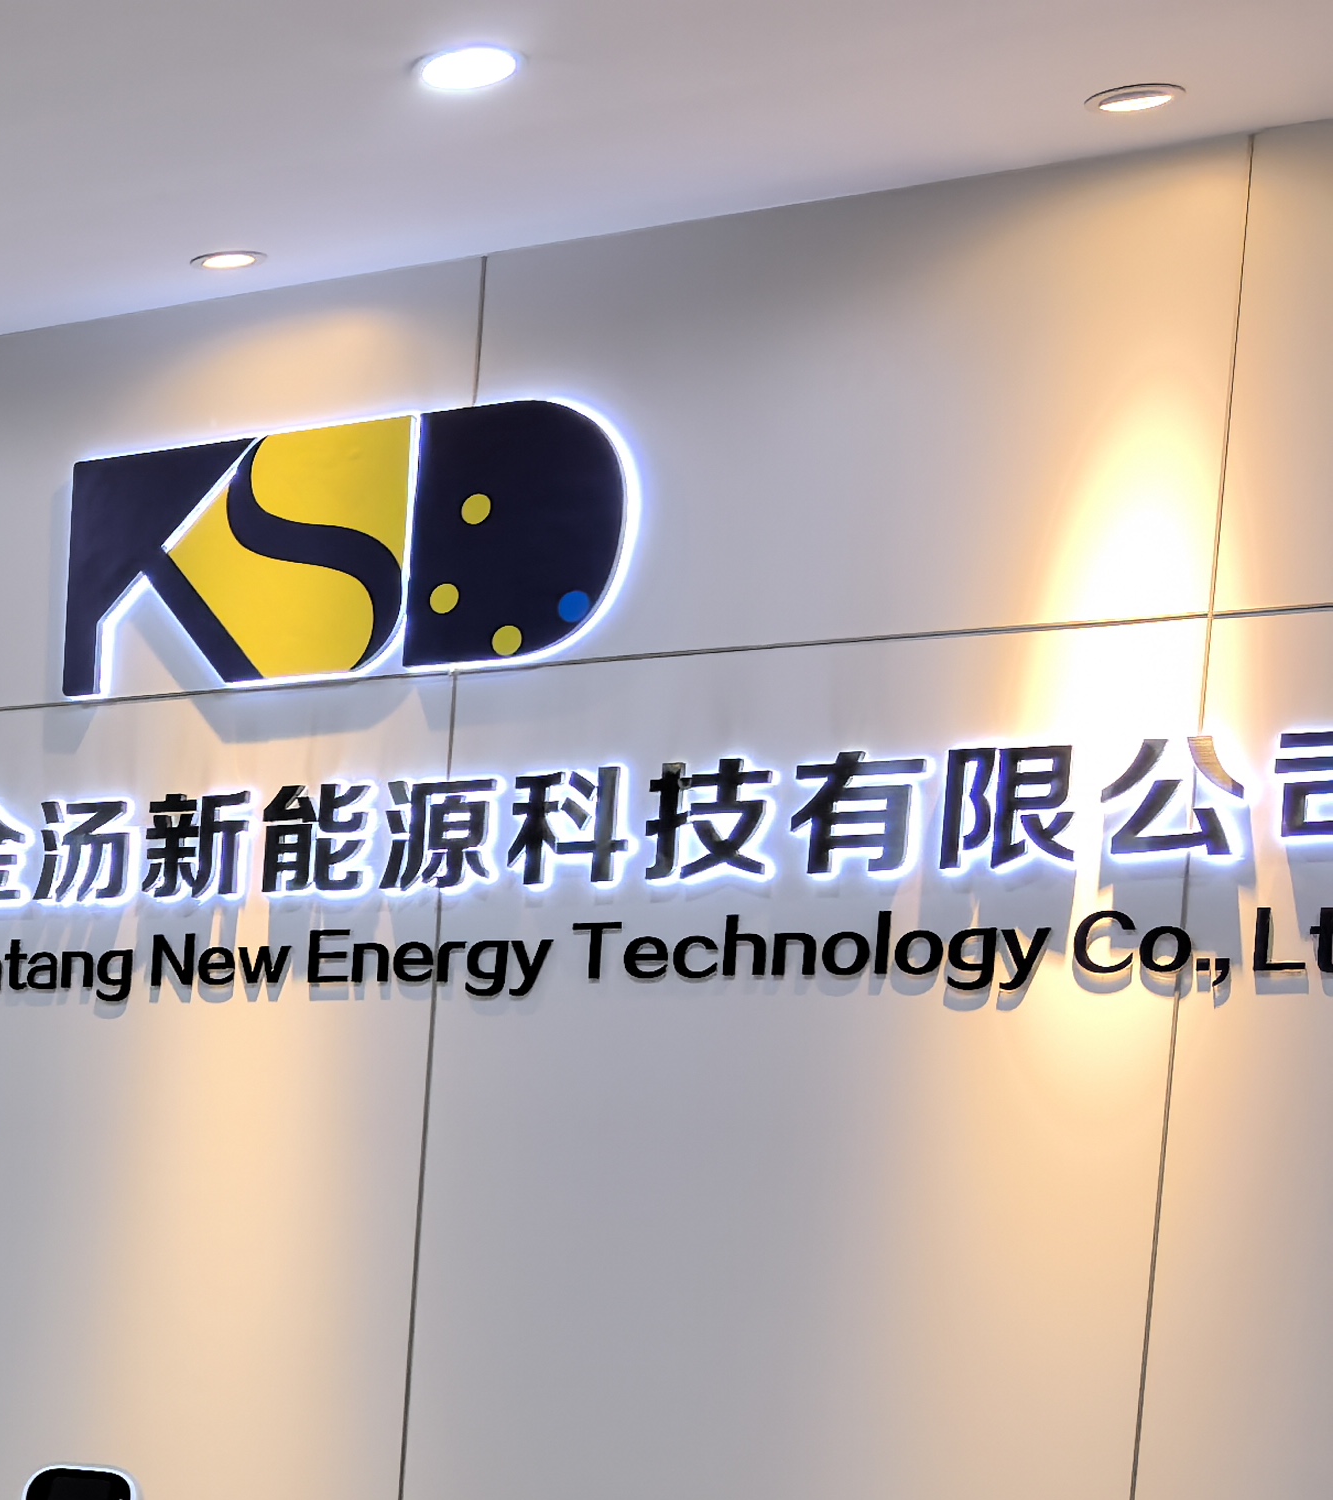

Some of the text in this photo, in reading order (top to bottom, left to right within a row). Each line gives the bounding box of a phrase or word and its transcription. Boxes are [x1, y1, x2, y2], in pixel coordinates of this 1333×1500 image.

[62, 399, 629, 697] KSD
[151, 933, 291, 987] New
[307, 928, 554, 996] Energy
[572, 910, 1052, 991] Technology
[1073, 909, 1230, 987] Co.,
